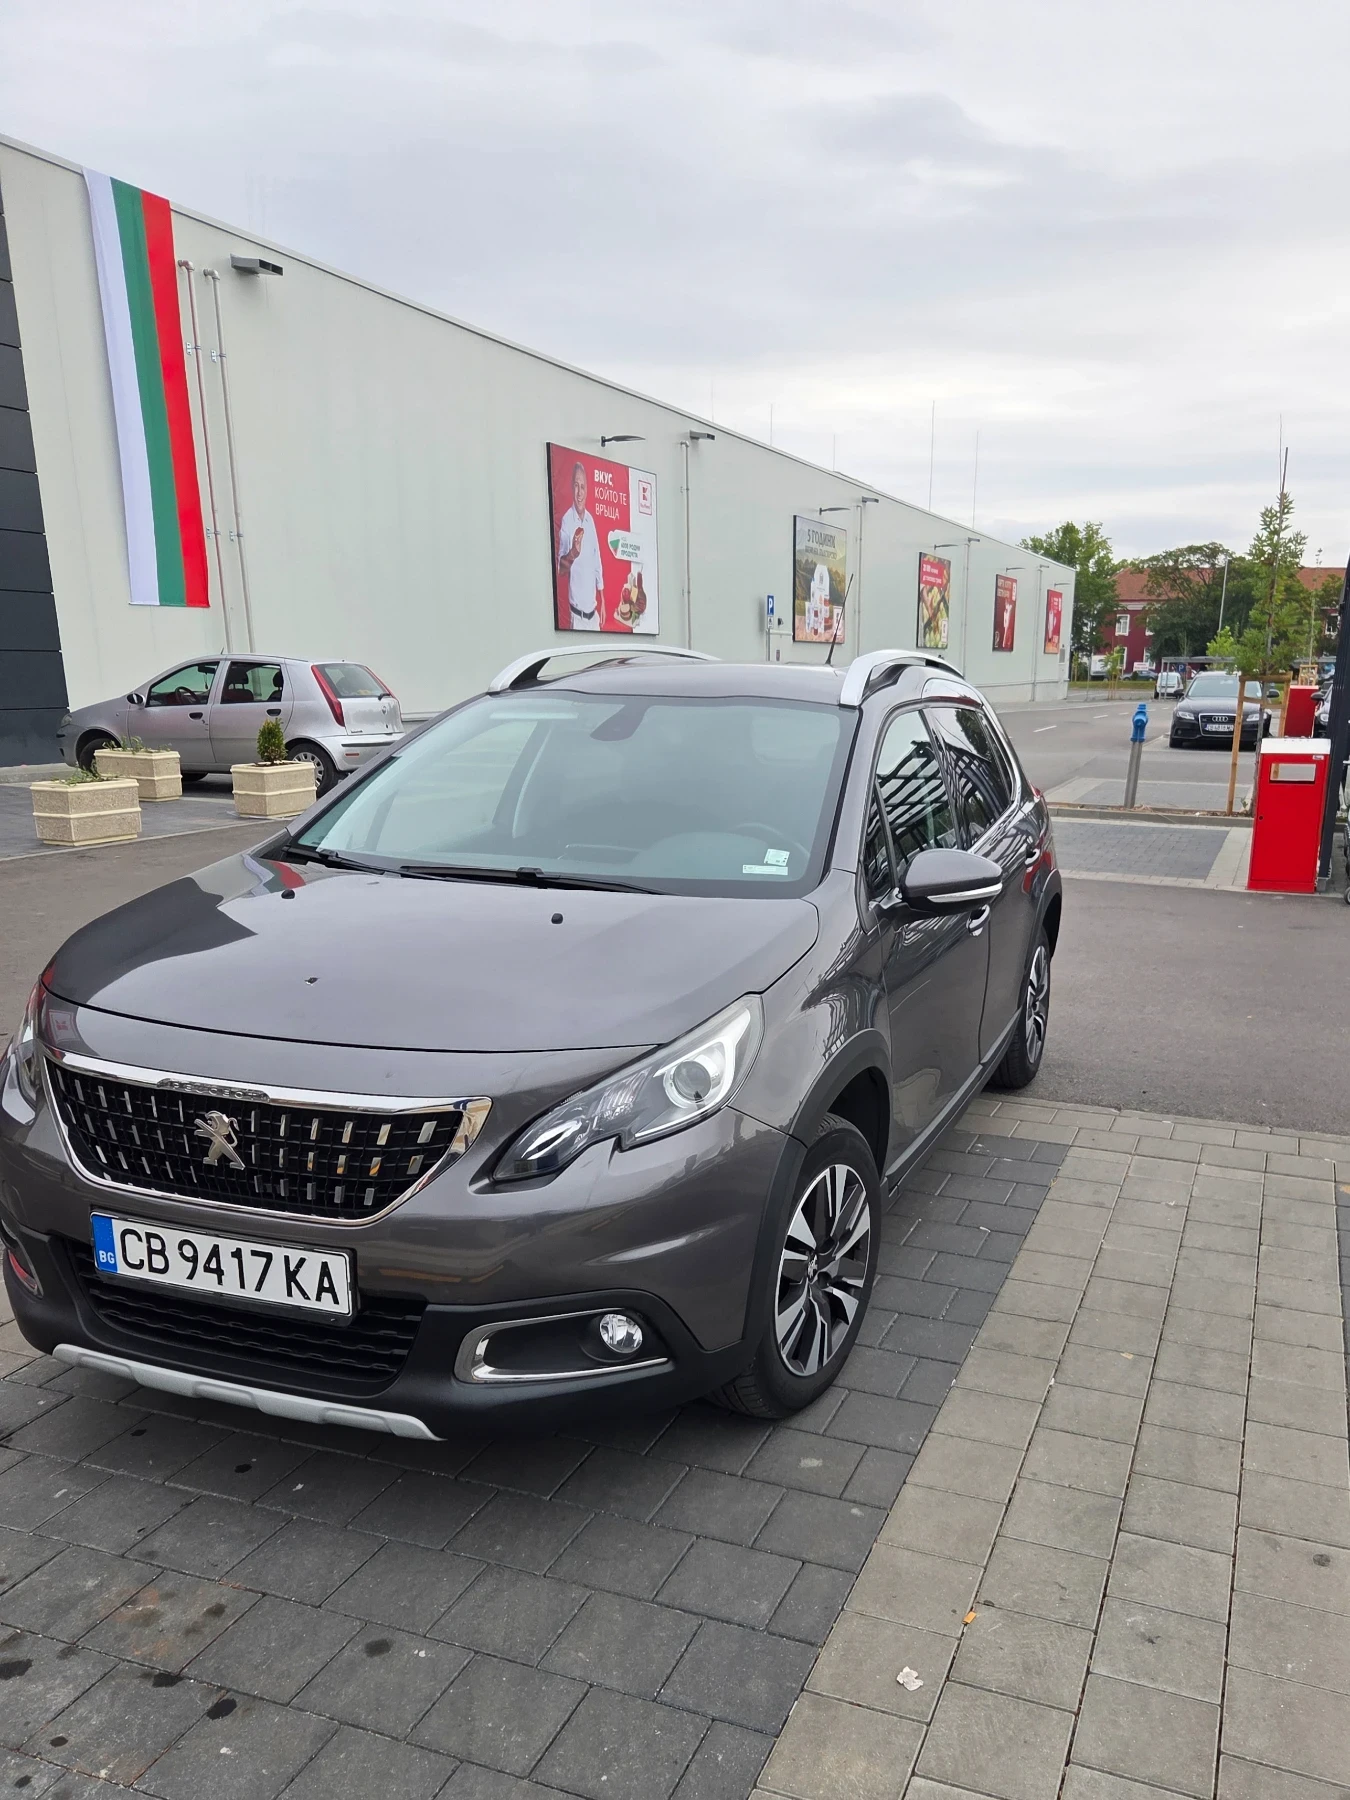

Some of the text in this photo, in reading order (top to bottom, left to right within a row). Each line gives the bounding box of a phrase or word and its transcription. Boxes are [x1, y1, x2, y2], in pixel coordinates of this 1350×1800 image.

[594, 470, 613, 487] ВКУС,
[595, 486, 618, 503] КОЙТО
[619, 492, 627, 506] ТЕ
[595, 503, 620, 521] ВРЪЩА
[768, 598, 773, 614] P
[99, 1250, 115, 1264] BG
[119, 1228, 340, 1306] CB 9417 KA
